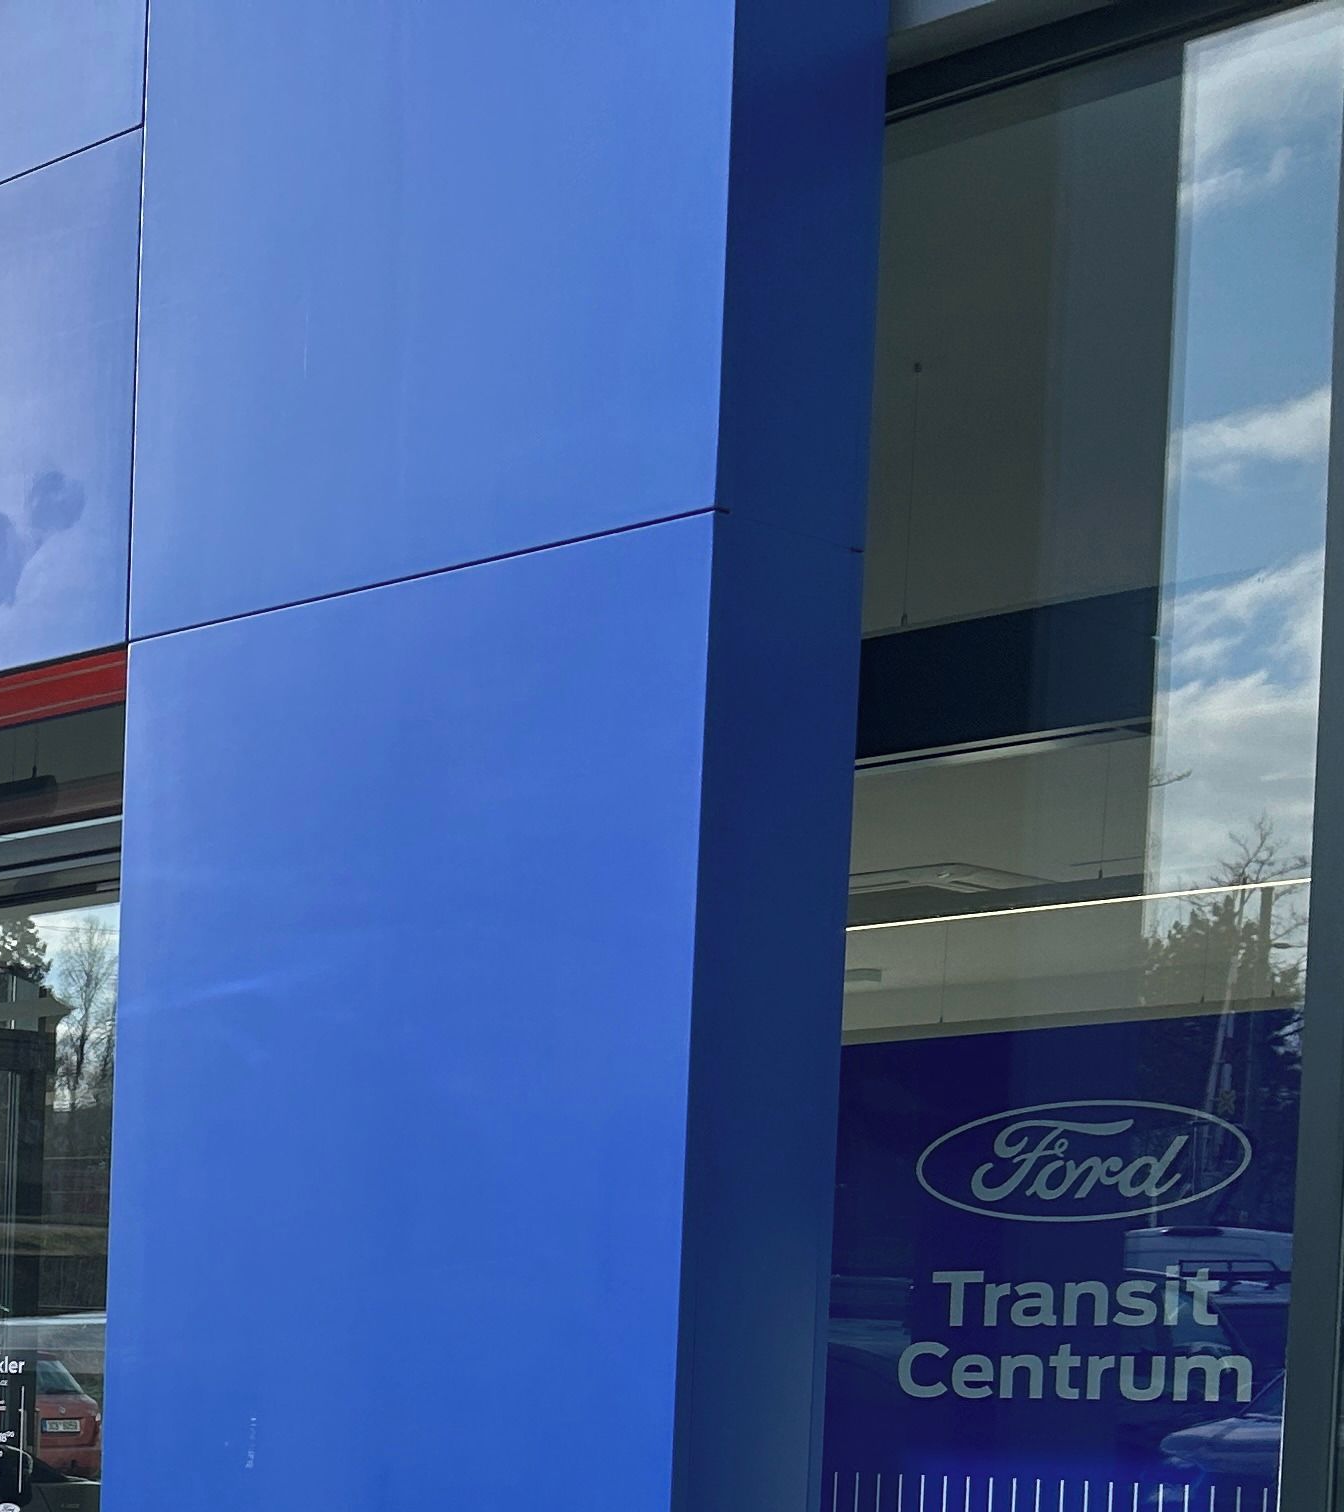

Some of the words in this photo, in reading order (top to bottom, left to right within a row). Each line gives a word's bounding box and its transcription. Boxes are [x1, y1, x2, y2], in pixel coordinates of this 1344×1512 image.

[970, 1118, 1190, 1202] Ford
[931, 1265, 1221, 1328] Transit
[897, 1341, 1254, 1403] Centrum
